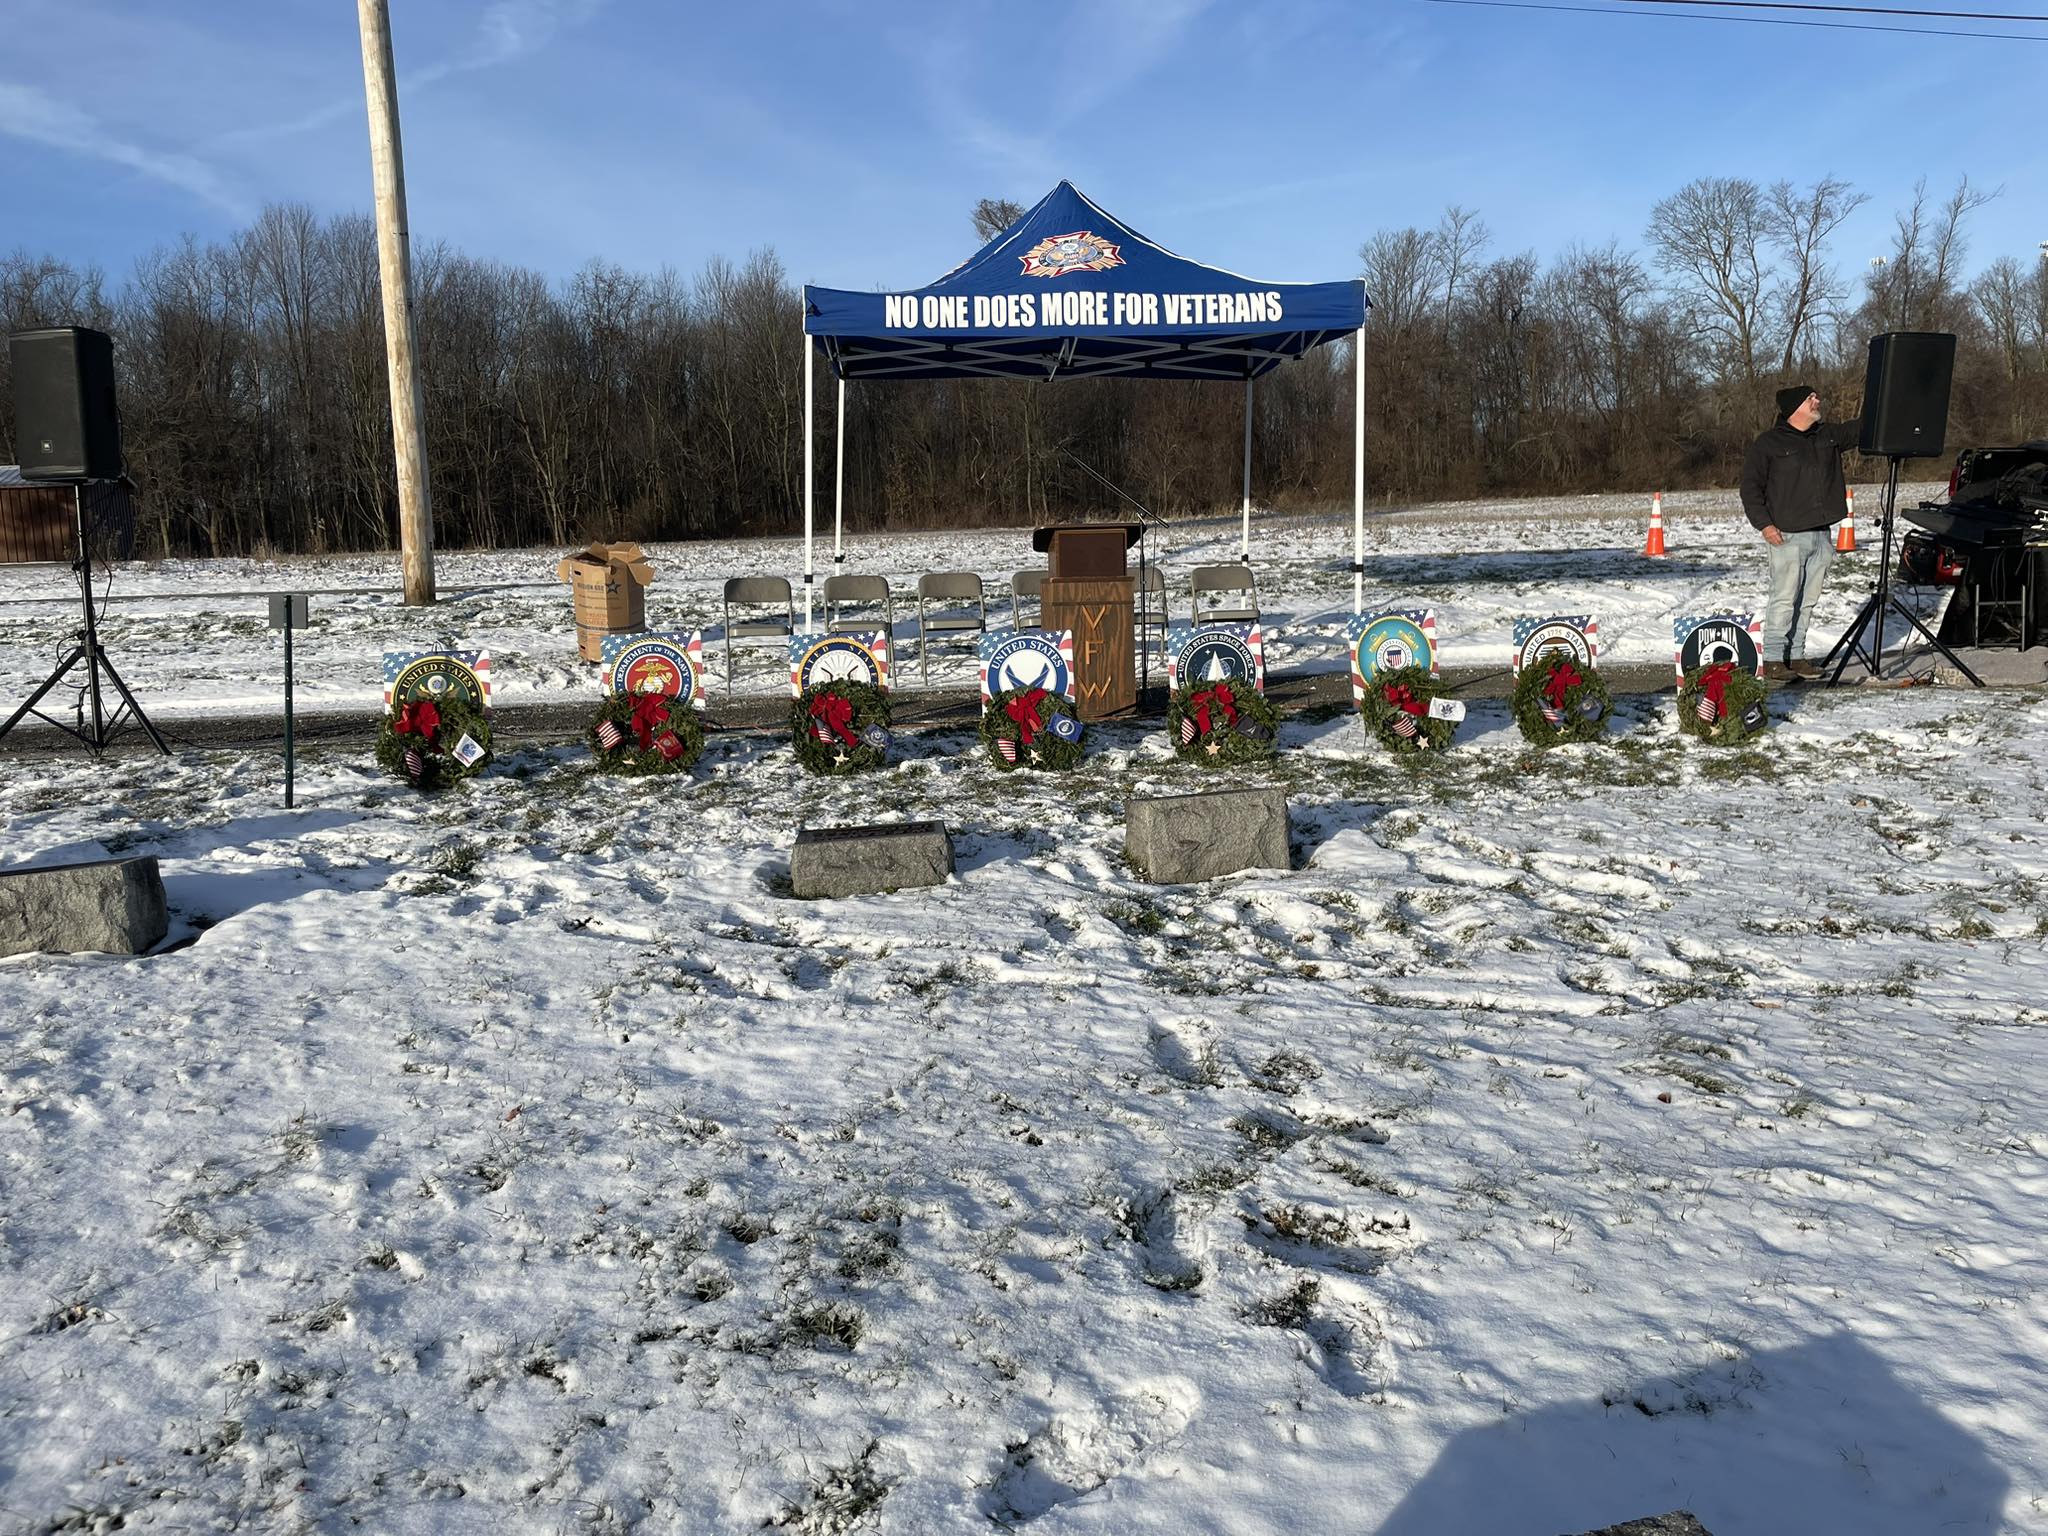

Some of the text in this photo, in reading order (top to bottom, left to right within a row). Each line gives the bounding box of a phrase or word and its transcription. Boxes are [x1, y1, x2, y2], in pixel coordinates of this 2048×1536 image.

[885, 291, 1283, 329] NO ONE DOES MORE FOR VETERANS
[991, 640, 1063, 670] UNITED STATES
[1080, 605, 1112, 699] VFW
[1178, 634, 1254, 672] UNITED STATES SPACE FORCE
[1525, 633, 1546, 663] UNITED
[1565, 631, 1587, 659] STATES
[1698, 627, 1740, 655] POW MIA
[402, 663, 474, 689] UNITED STATES
[616, 645, 653, 682] DEPARTMENT
[663, 648, 675, 659] THE
[675, 657, 690, 678] NAVY
[803, 646, 829, 690] UNITED
